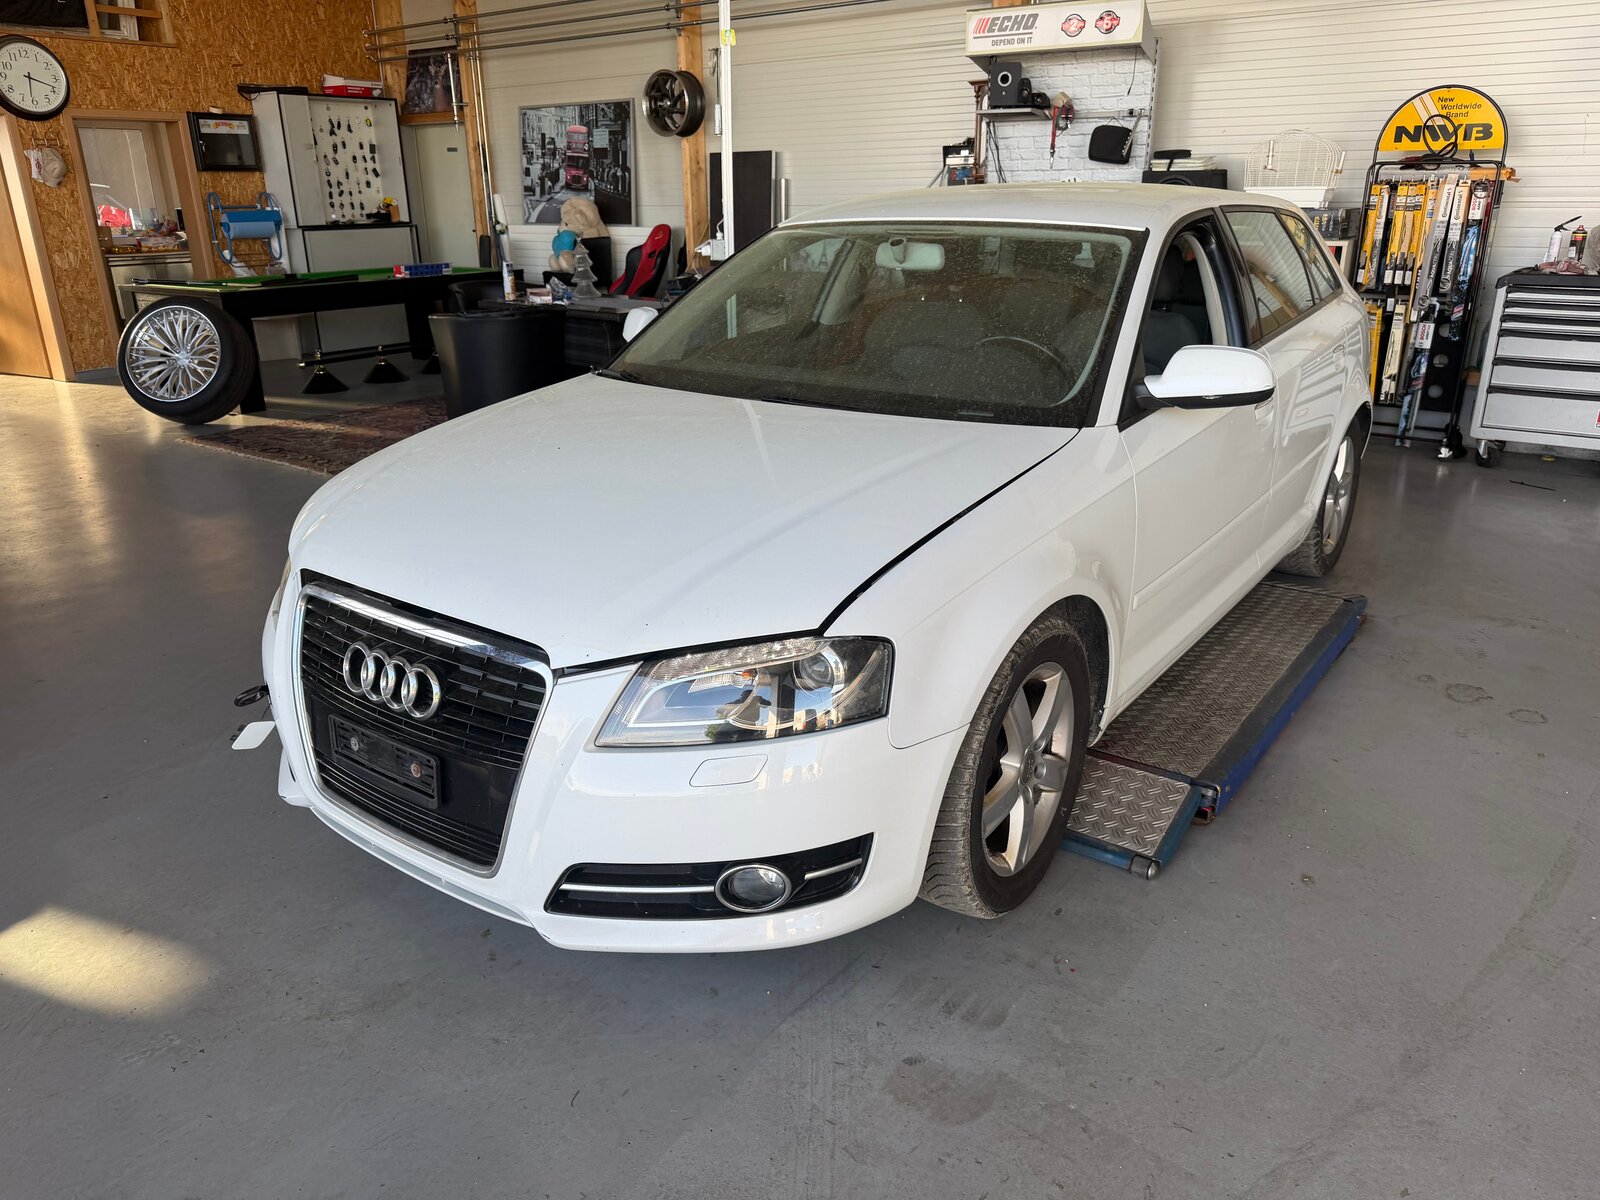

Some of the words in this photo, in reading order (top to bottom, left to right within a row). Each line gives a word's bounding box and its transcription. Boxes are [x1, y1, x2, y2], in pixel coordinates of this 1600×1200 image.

[987, 13, 1039, 34] ECHO
[991, 38, 1016, 47] DEPEND
[1016, 37, 1026, 45] ON
[1026, 36, 1033, 44] IT
[8, 52, 17, 61] 11
[18, 49, 29, 59] 12
[34, 53, 39, 62] 1
[1, 61, 12, 71] 10
[43, 61, 50, 71] 2
[0, 72, 7, 81] 9
[51, 74, 58, 83] 3
[7, 84, 15, 93] 8
[19, 93, 25, 102] 7
[31, 97, 39, 106] 6
[44, 94, 51, 105] 5
[1393, 123, 1493, 143] NWB
[1441, 192, 1451, 217] Continental
[1454, 194, 1463, 220] Continental
